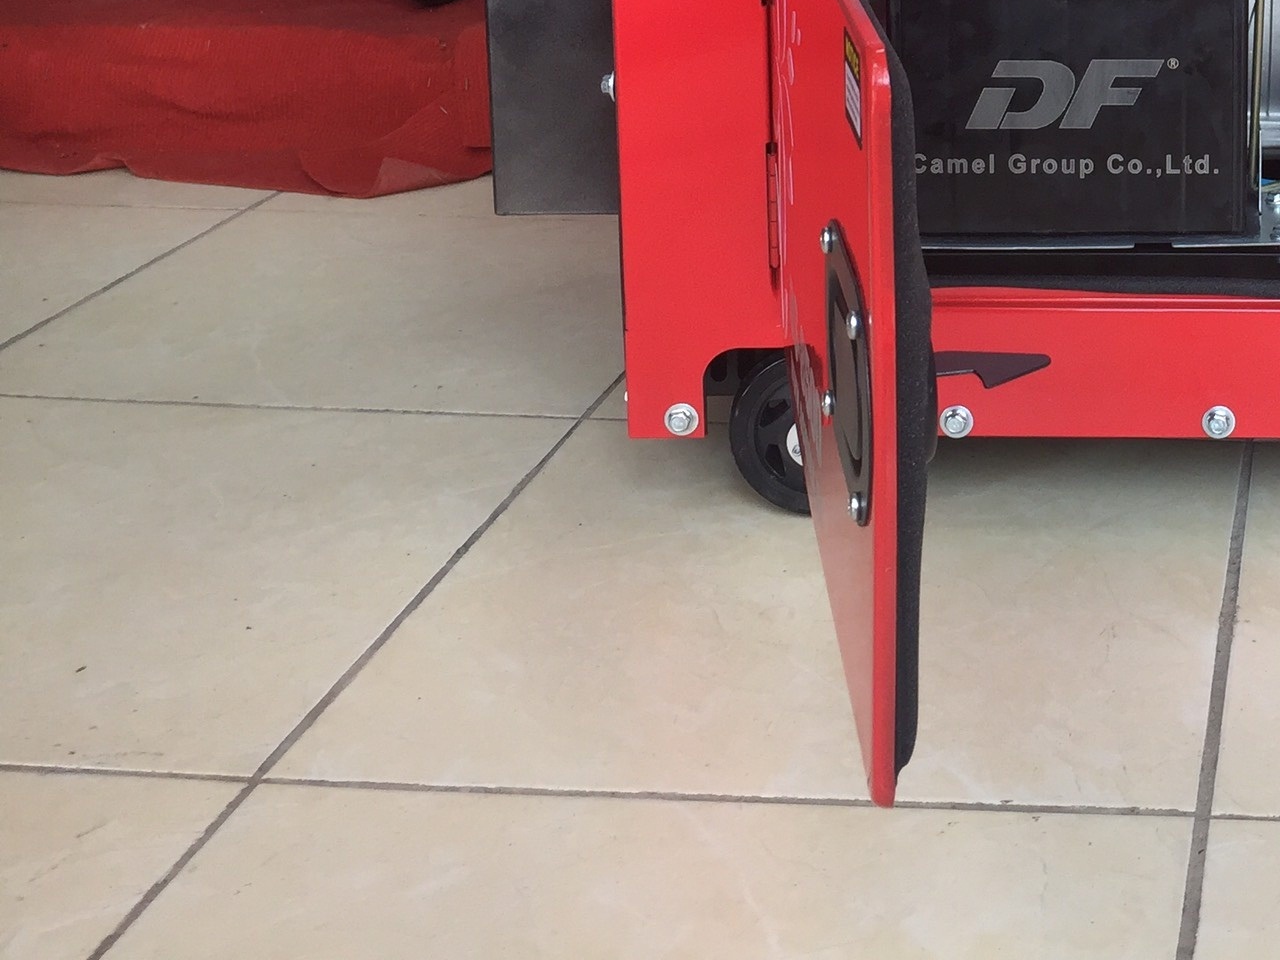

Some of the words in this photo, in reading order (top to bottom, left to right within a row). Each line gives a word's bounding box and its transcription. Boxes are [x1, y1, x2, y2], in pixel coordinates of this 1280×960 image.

[964, 58, 1165, 130] DF
[914, 153, 995, 174] Camel
[1008, 153, 1095, 179] Group
[1106, 153, 1220, 178] Co.,Ltd.
